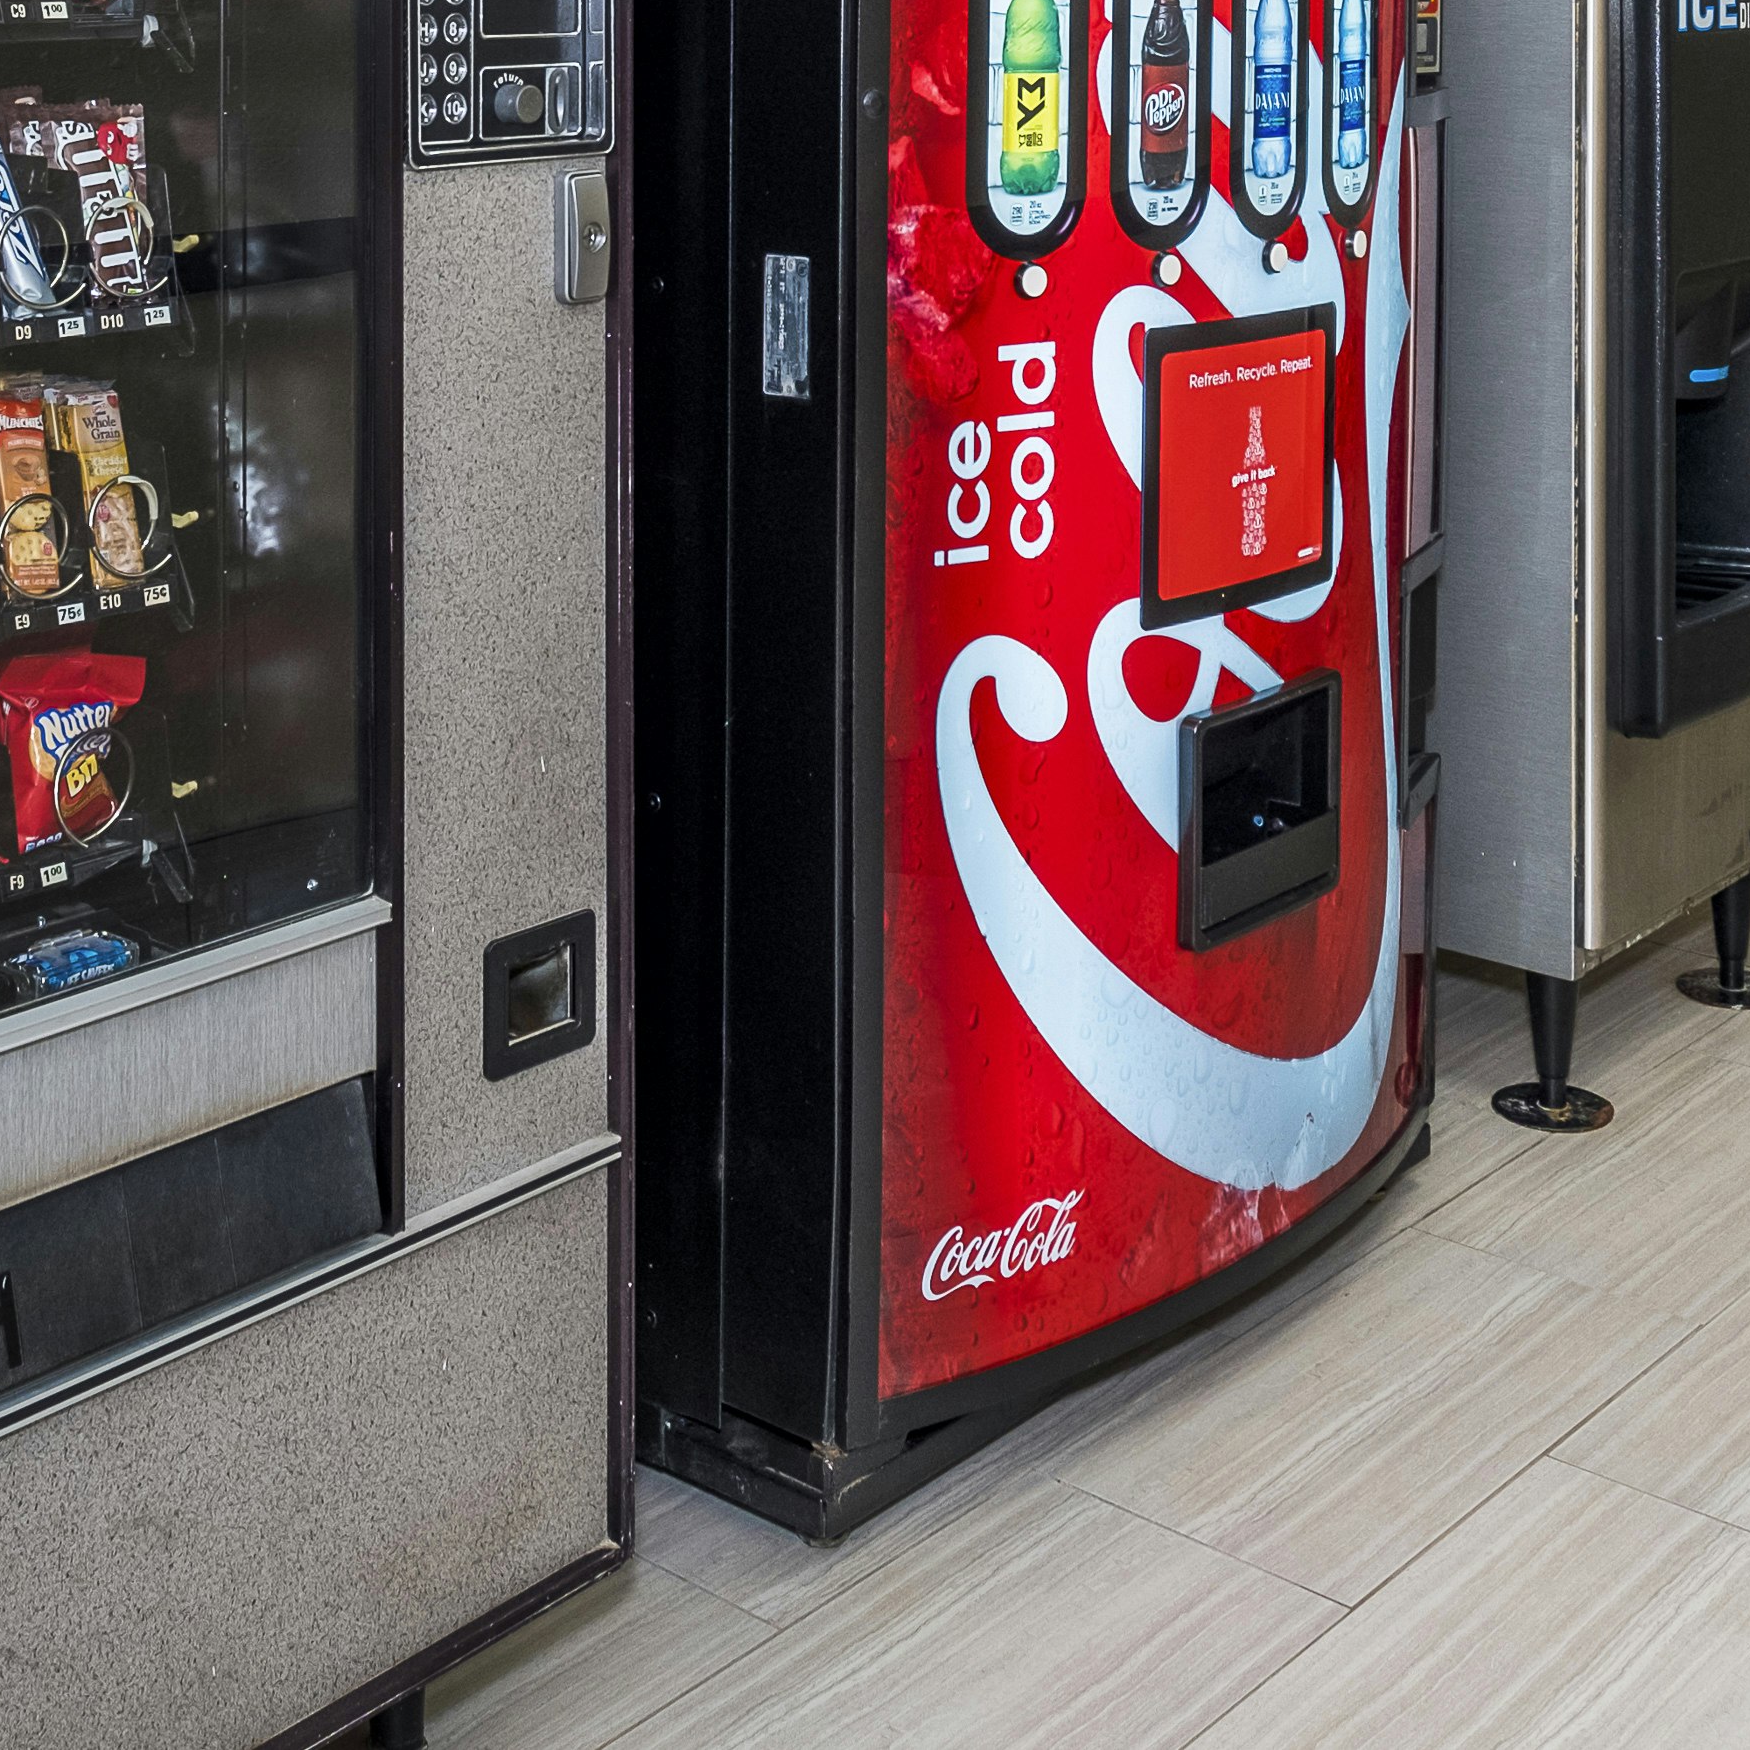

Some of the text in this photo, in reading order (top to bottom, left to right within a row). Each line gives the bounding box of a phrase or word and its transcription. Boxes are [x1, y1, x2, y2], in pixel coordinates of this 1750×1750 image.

[11, 2, 26, 18] C9
[449, 21, 457, 36] 8
[449, 61, 457, 77] 9
[493, 72, 525, 89] return
[1158, 89, 1175, 105] Dr
[447, 101, 460, 116] 10
[1146, 93, 1182, 126] Pepper
[101, 314, 124, 329] D10
[16, 326, 32, 341] D9
[1189, 355, 1313, 389] Refresh. Recycle. Repeat.
[83, 415, 117, 429] Whole
[91, 428, 121, 441] Grain
[997, 340, 1056, 560] cold
[1232, 466, 1276, 487] give it back
[934, 419, 991, 567] ice
[100, 594, 120, 609] E10
[15, 615, 30, 630] E9
[9, 874, 24, 890] F9
[922, 1187, 1086, 1301] Coca-Cola
